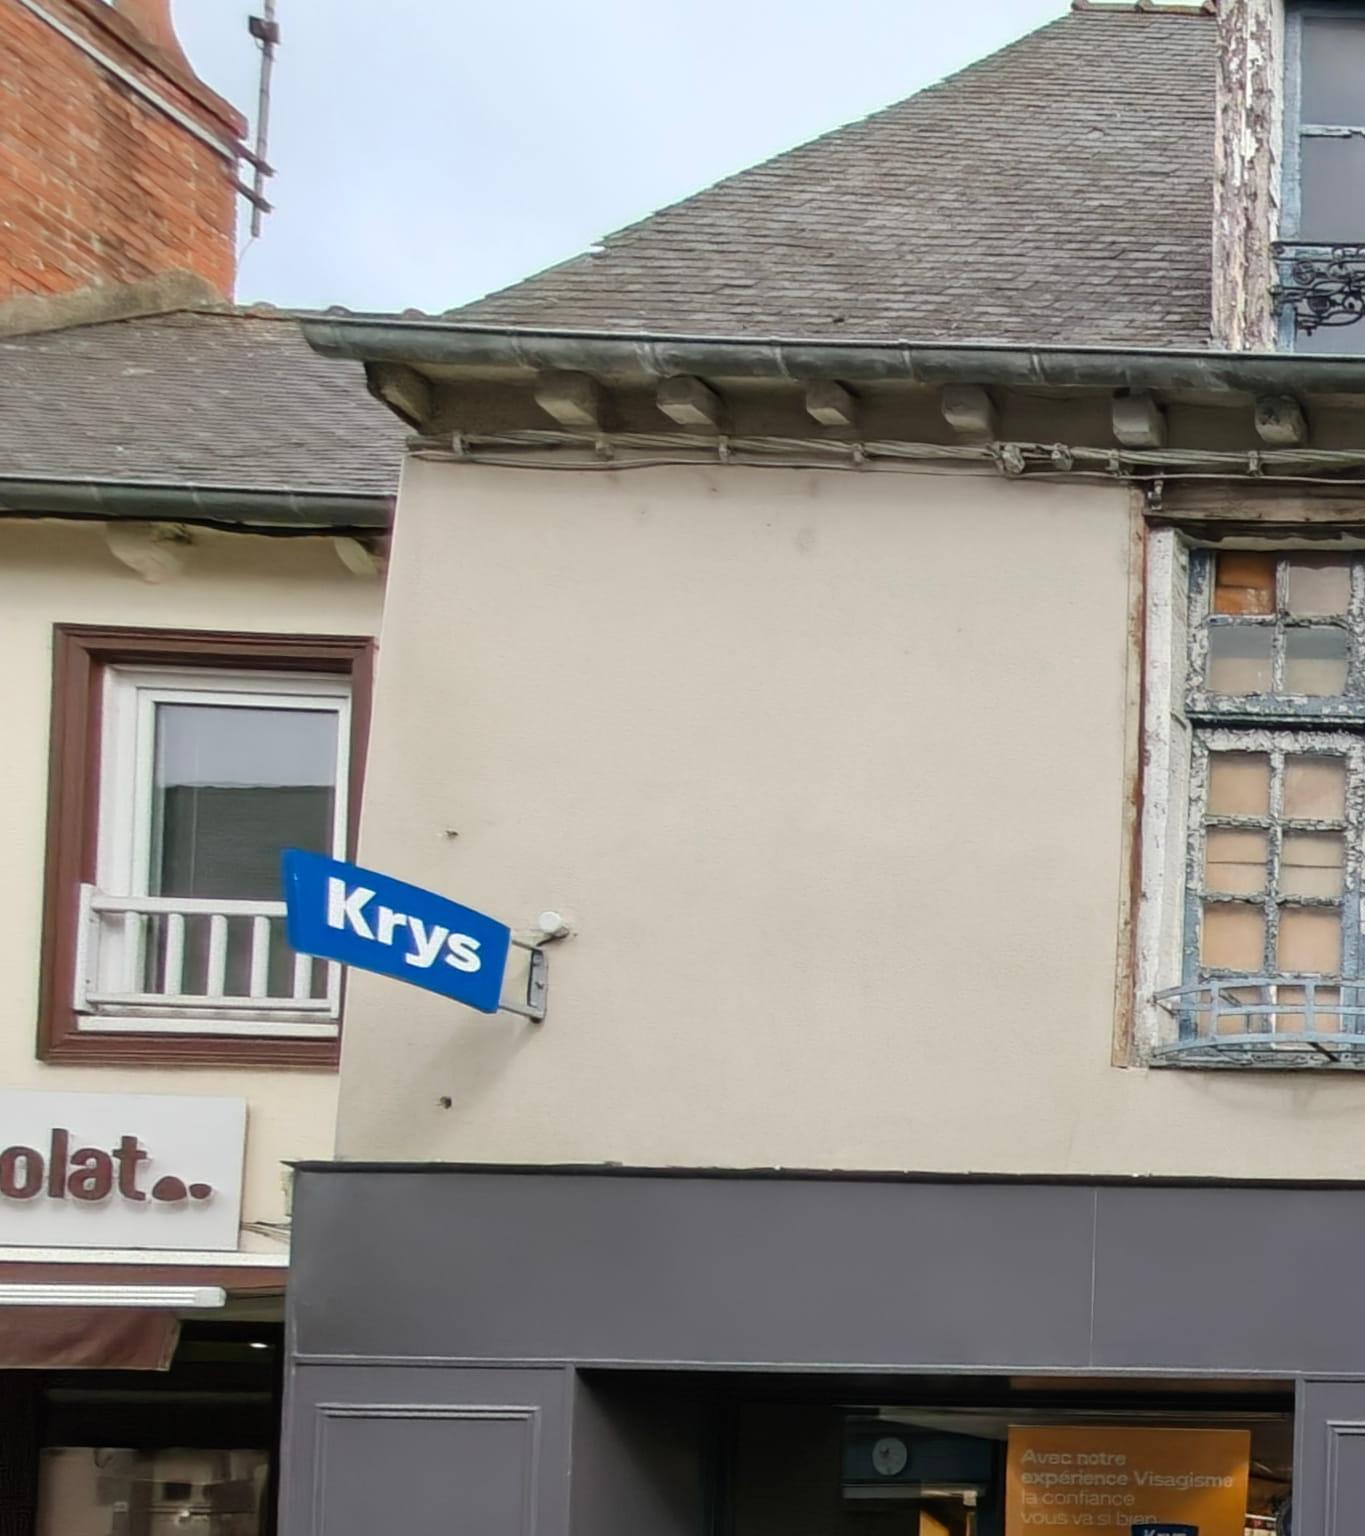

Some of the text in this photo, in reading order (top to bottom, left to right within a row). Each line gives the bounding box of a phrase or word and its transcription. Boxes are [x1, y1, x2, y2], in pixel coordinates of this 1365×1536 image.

[327, 876, 481, 973] Krys
[1021, 1450, 1126, 1466] Avec notre
[1021, 1470, 1234, 1491] expérience Visagisme
[1021, 1488, 1135, 1507] la confiance
[1021, 1511, 1157, 1527] vous va si bien
